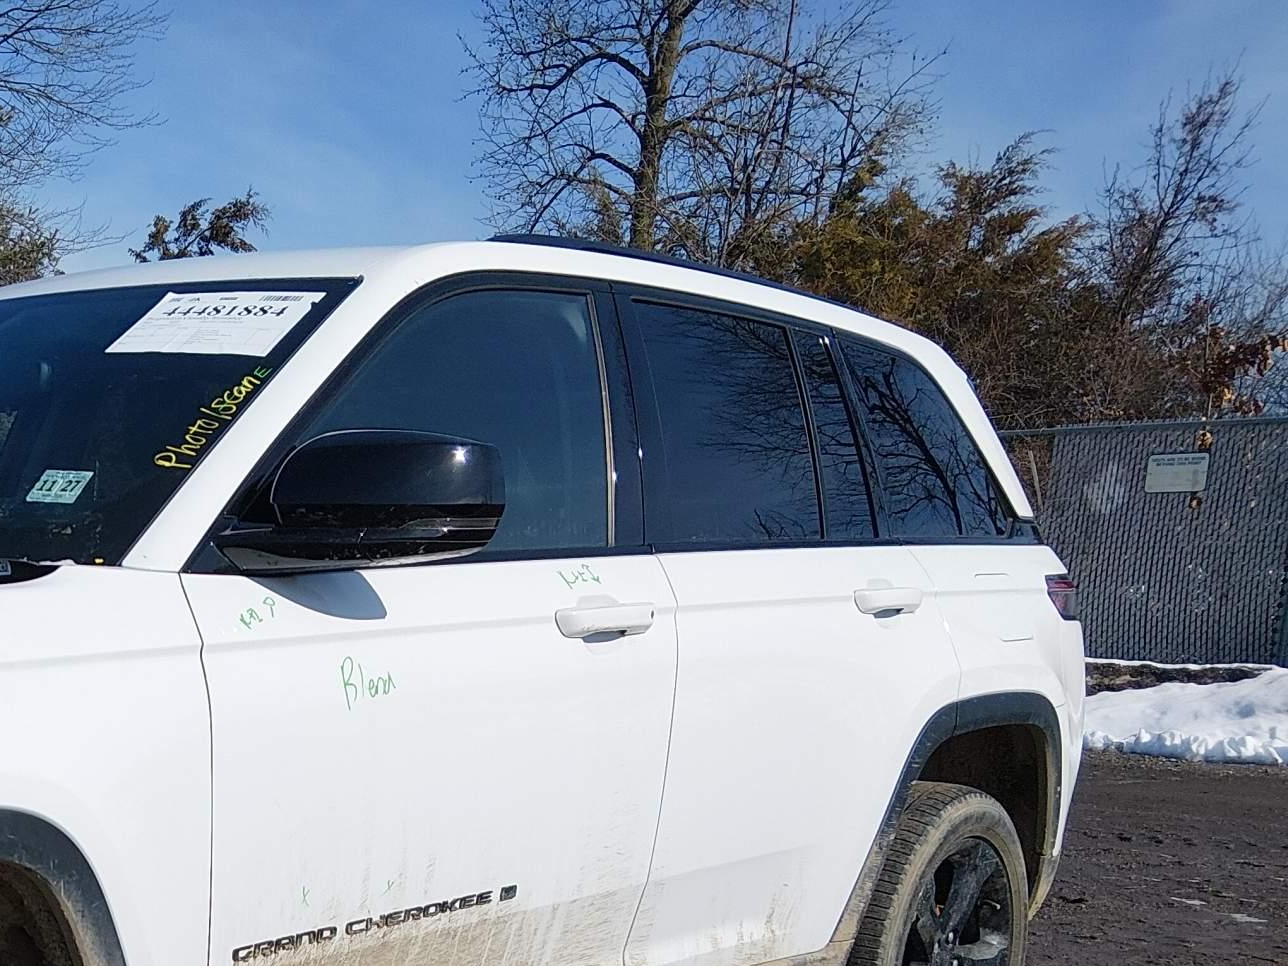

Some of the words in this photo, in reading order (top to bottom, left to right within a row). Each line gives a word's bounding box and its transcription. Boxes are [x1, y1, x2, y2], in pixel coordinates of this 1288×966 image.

[162, 304, 289, 317] 44481884
[36, 480, 58, 492] 11
[60, 480, 83, 493] 27
[232, 926, 337, 962] GRAND
[345, 890, 492, 935] CHEROKEE
